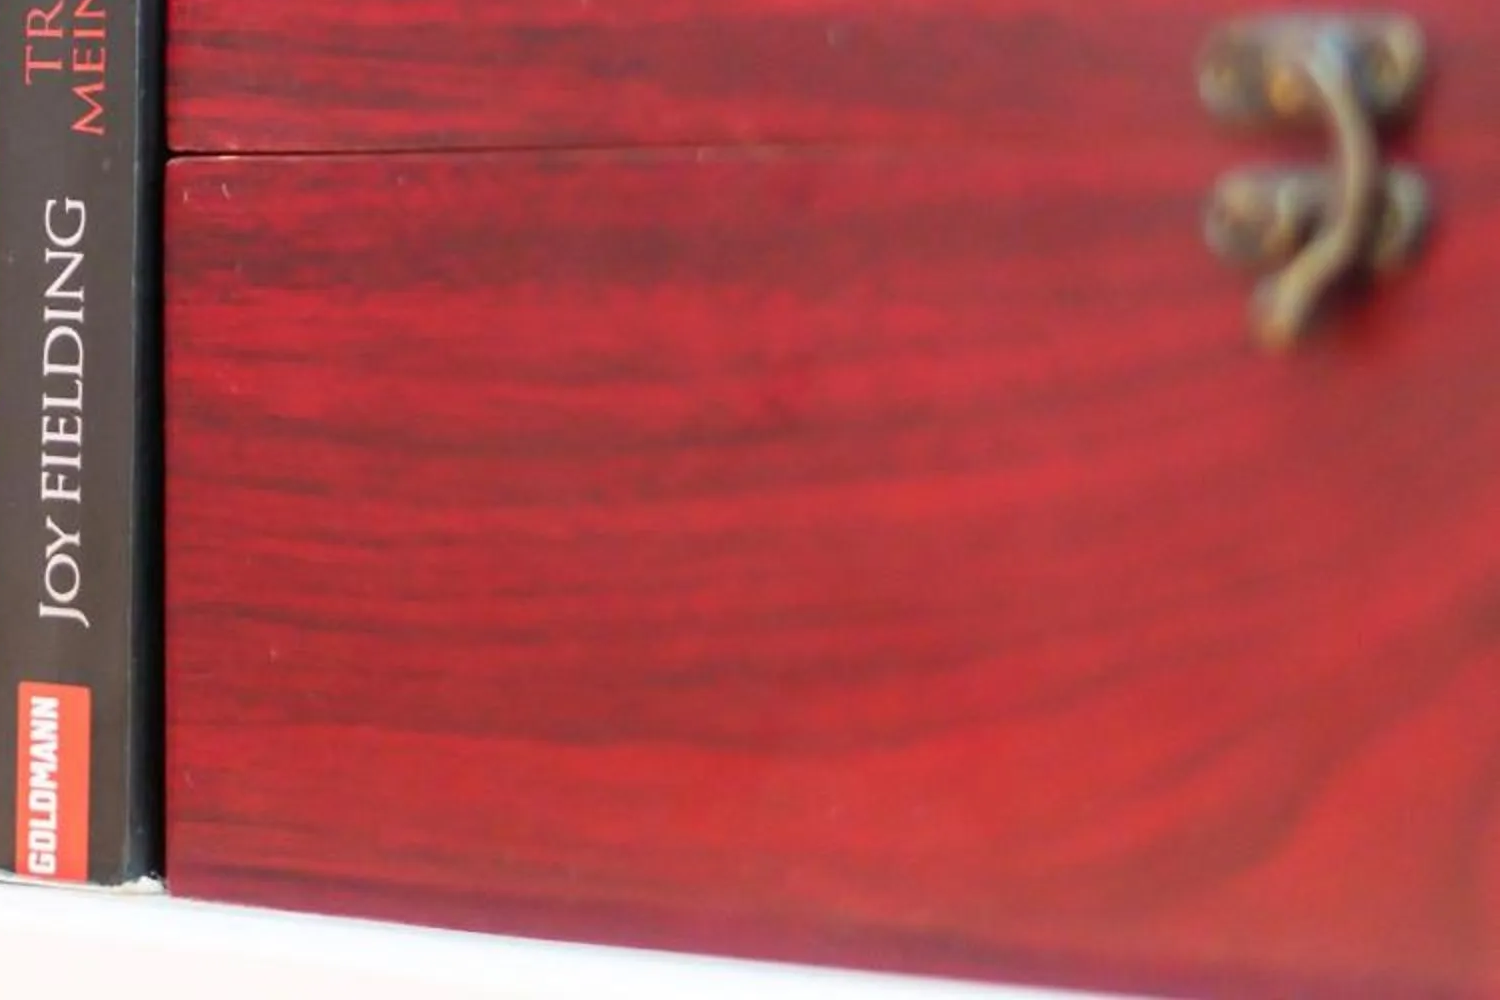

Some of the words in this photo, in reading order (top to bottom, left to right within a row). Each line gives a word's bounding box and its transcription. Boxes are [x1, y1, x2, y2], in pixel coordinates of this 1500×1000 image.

[40, 196, 87, 503] FIELDING
[39, 514, 91, 628] JOY
[27, 695, 59, 877] GOLDMANN
